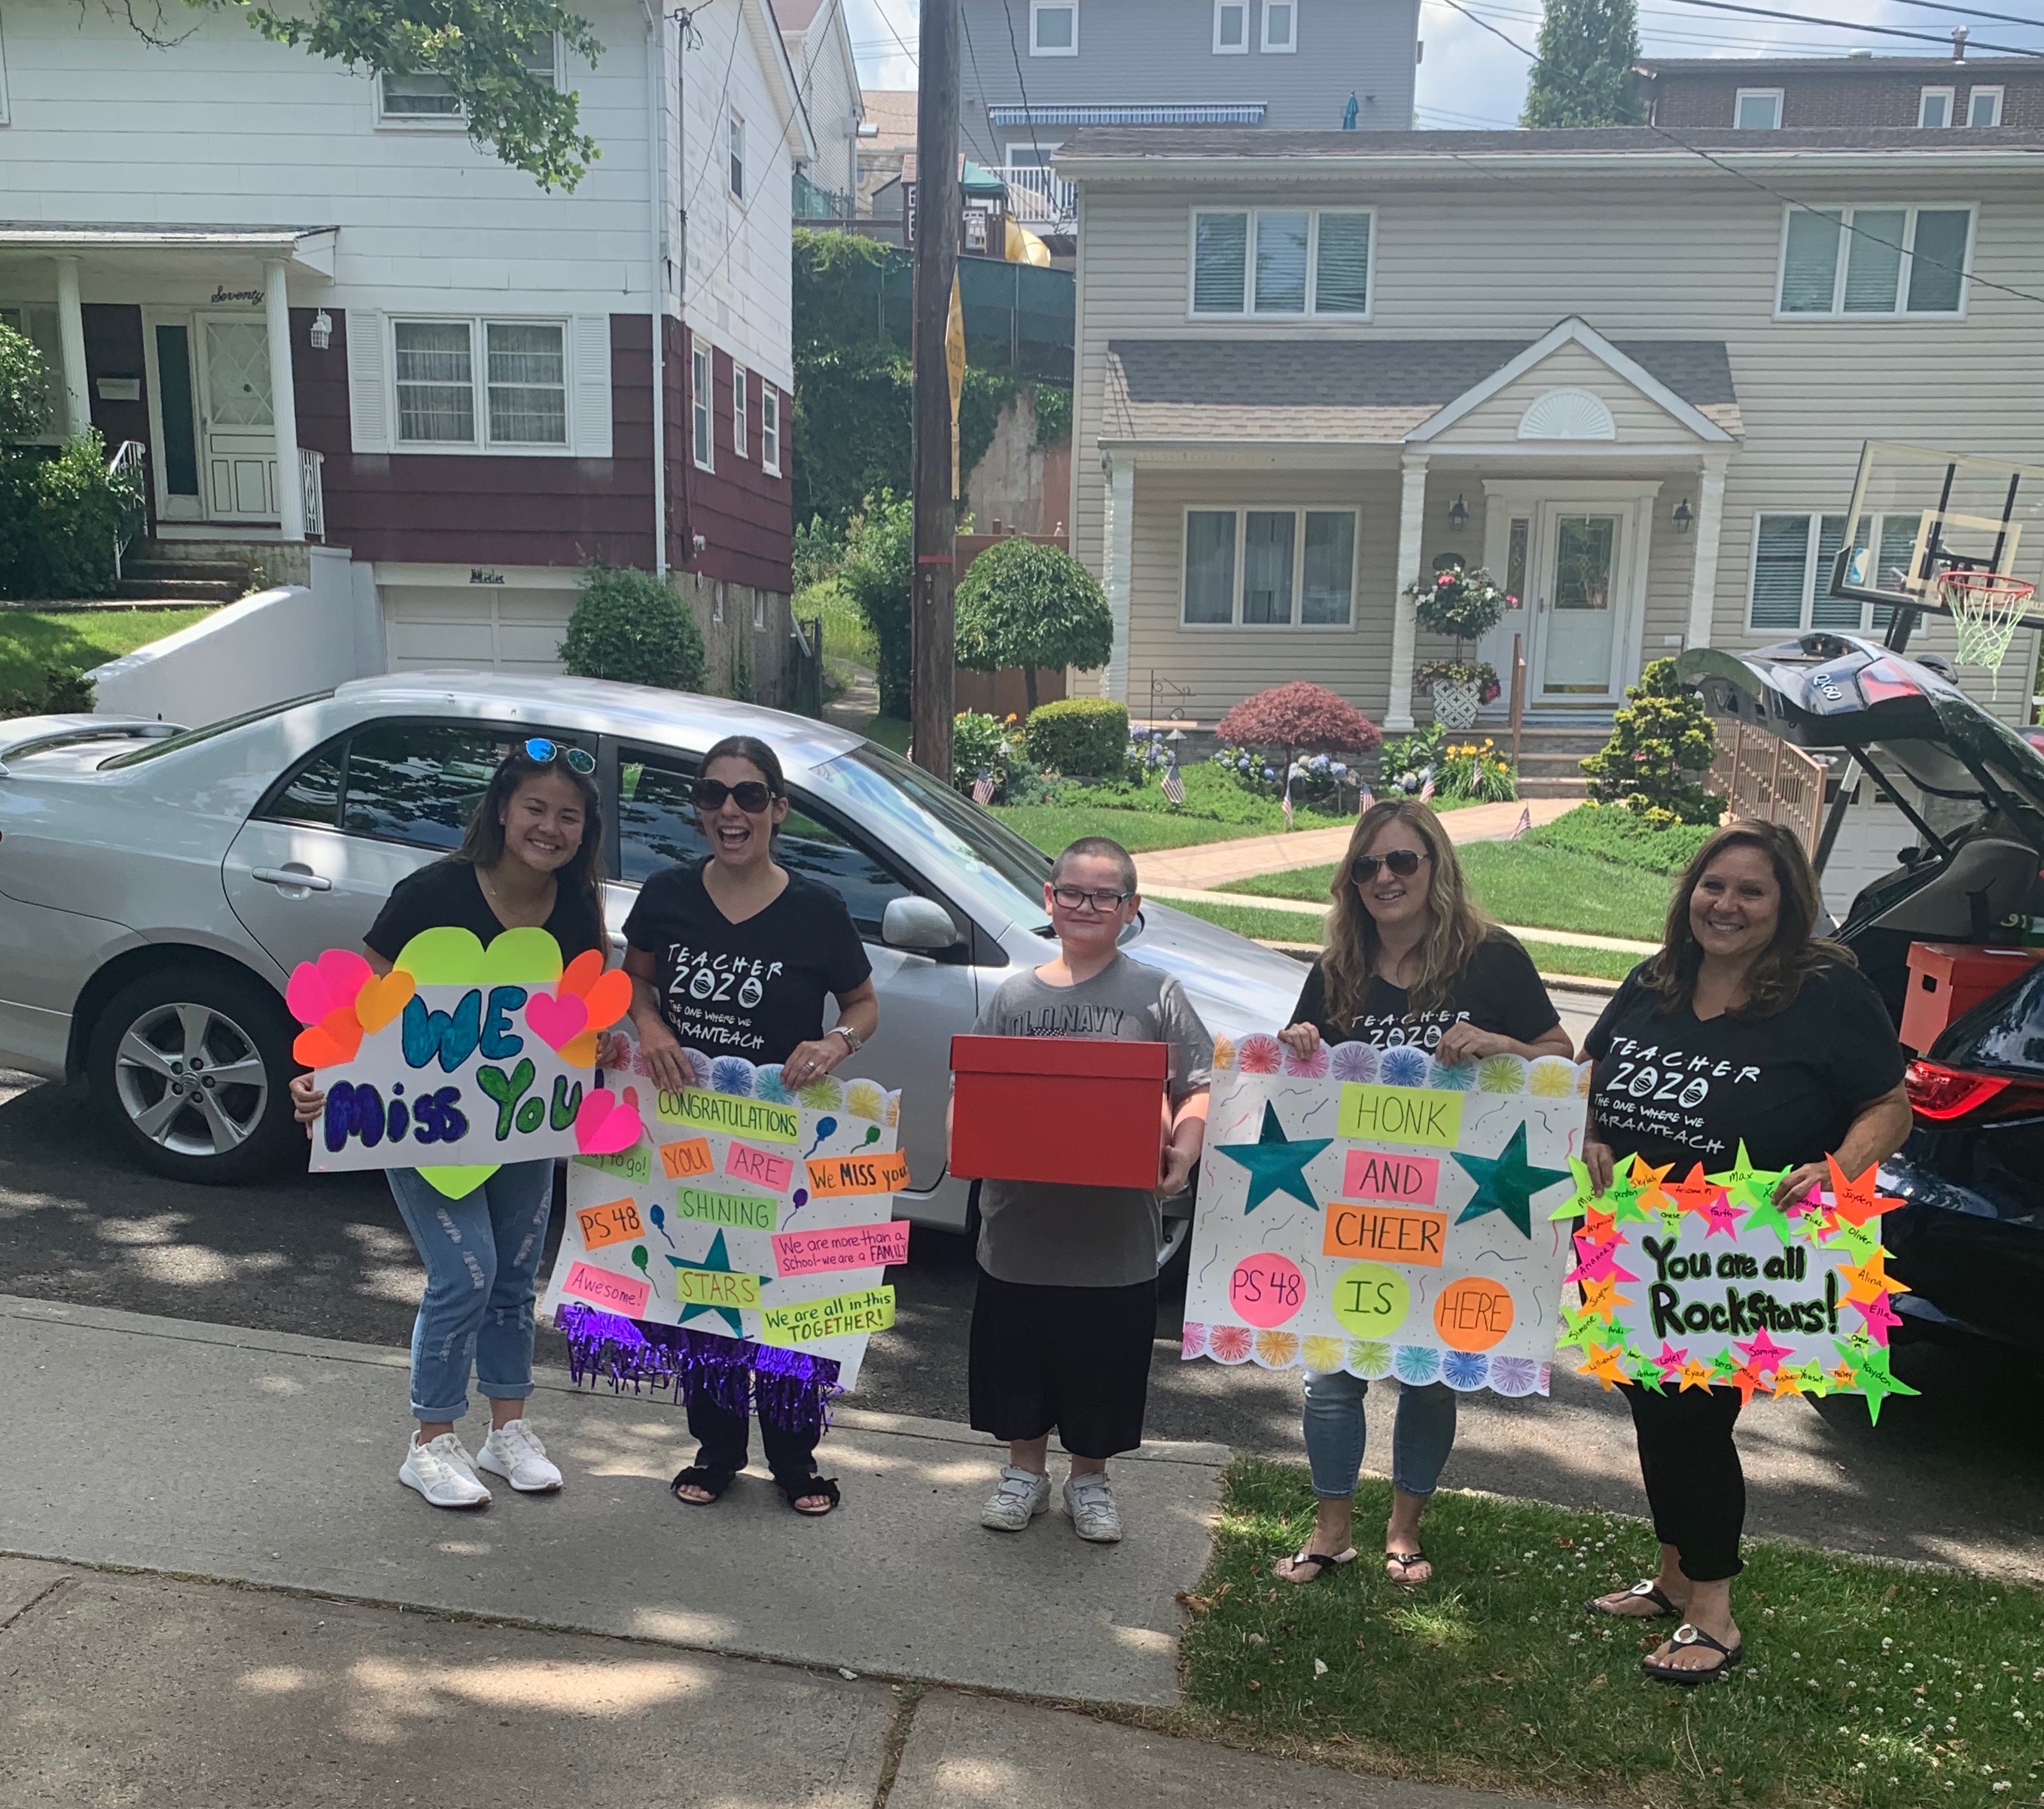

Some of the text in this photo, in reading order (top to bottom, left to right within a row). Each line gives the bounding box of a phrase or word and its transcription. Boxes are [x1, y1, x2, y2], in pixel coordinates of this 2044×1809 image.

[211, 285, 265, 306] Seventy
[1814, 673, 1842, 700] QX60
[669, 965, 763, 1009] 2020
[401, 985, 528, 1074] WE
[684, 1005, 702, 1018] ONE
[705, 1010, 736, 1025] WHERE
[738, 1016, 752, 1027] WE
[1010, 1004, 1124, 1036] OLD NAVY
[476, 1058, 583, 1141] You
[1606, 1061, 1709, 1108] 2020
[658, 1089, 798, 1137] CONGRATULATIONS
[1357, 1092, 1448, 1138] HONK
[1594, 1093, 1705, 1128] THE ONE WHERE WE
[626, 1156, 647, 1177] go!
[664, 1147, 784, 1185] YOU ARE
[809, 1165, 836, 1189] We
[840, 1162, 877, 1186] MISS
[1359, 1158, 1423, 1195] AND
[1729, 1171, 1754, 1183] Max
[683, 1190, 770, 1229] SHINING
[1842, 1187, 1873, 1208] Jayden
[580, 1206, 641, 1242] PS 48
[1335, 1211, 1440, 1254] CHEER
[1848, 1227, 1872, 1246] Oliver
[778, 1229, 906, 1256] We are more than a
[839, 1253, 855, 1265] are
[858, 1252, 866, 1262] a
[1642, 1235, 1808, 1283] You are all
[571, 1268, 644, 1308] Awesome!
[682, 1271, 754, 1303] STARS
[1232, 1268, 1302, 1307] PS 48
[1858, 1268, 1884, 1288] Alina
[766, 1292, 891, 1329] We are all in this
[1343, 1280, 1394, 1316] IS
[1439, 1290, 1511, 1332] HERE
[1869, 1305, 1894, 1322] Ella
[787, 1308, 884, 1343] TOGETHER!
[1568, 1315, 1598, 1341] Simone
[1684, 1367, 1706, 1380] Eyad
[1862, 1361, 1891, 1387] Kayden
